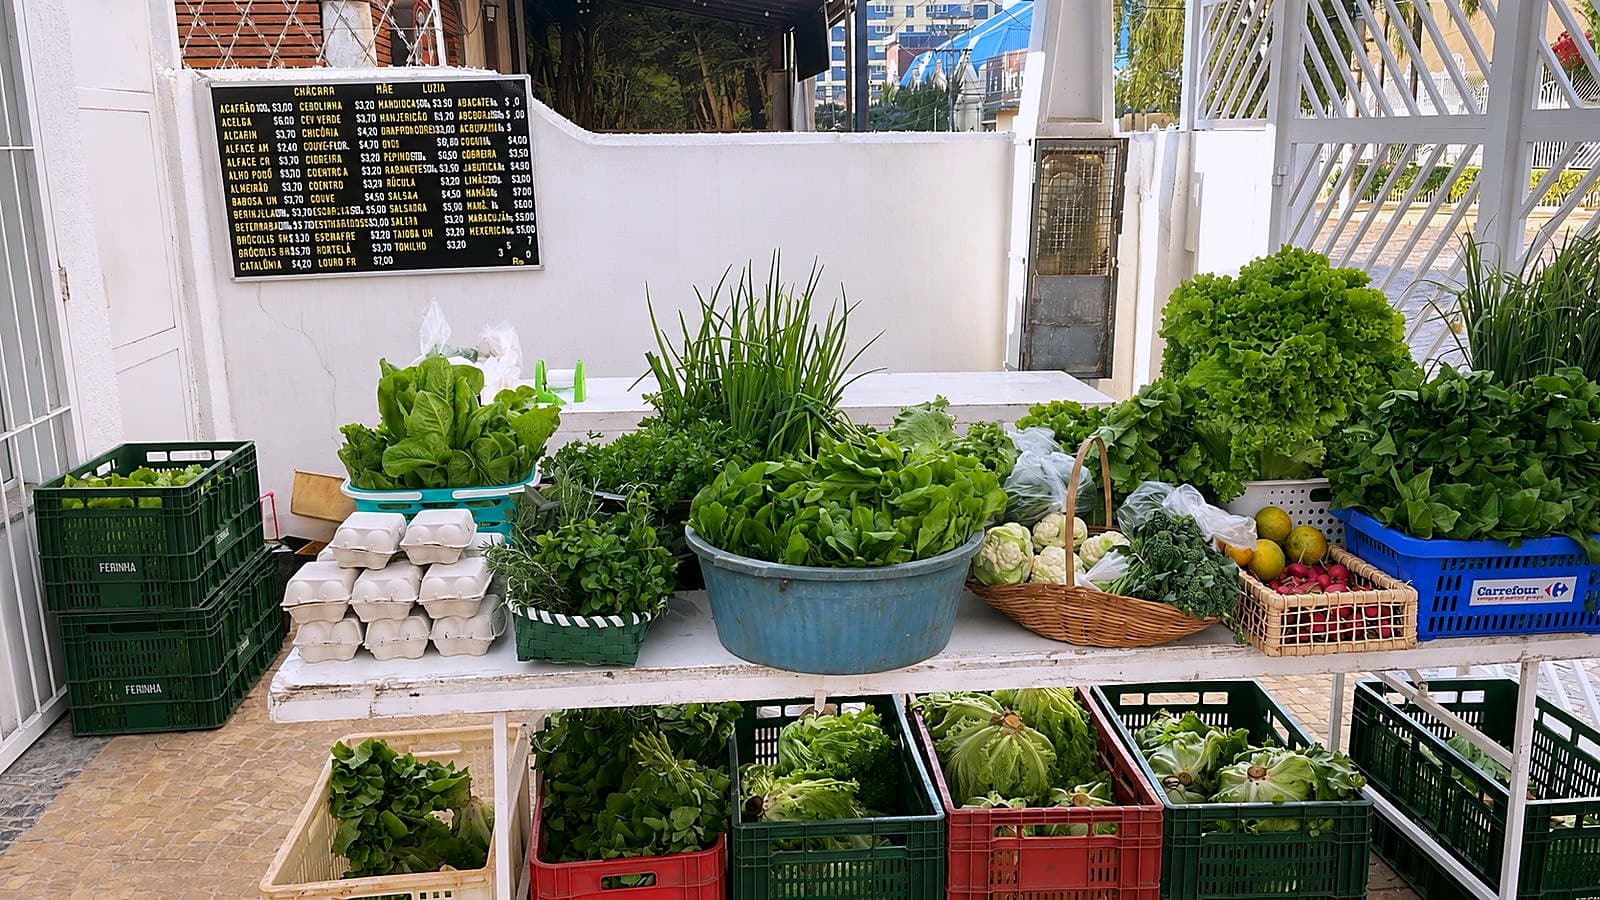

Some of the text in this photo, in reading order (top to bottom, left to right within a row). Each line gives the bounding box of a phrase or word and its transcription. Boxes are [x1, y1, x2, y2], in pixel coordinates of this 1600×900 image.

[422, 83, 446, 94] LUZIA
[222, 117, 252, 127] ACELGA
[316, 114, 342, 124] VERDE
[356, 114, 376, 124] $3,70
[226, 144, 255, 154] ALFACE
[277, 143, 297, 152] $2,40
[227, 157, 256, 167] ALFACE
[360, 153, 380, 163] $3,20
[229, 170, 249, 180] ALHO
[362, 166, 382, 176] $3,20
[232, 196, 263, 206] BABOSA
[311, 194, 335, 203] COUVE
[498, 248, 503, 257] 3
[318, 258, 343, 268] LOURO
[99, 562, 136, 573] FERINHA
[1477, 586, 1539, 596] Carrefour
[125, 684, 162, 694] FERINHA
